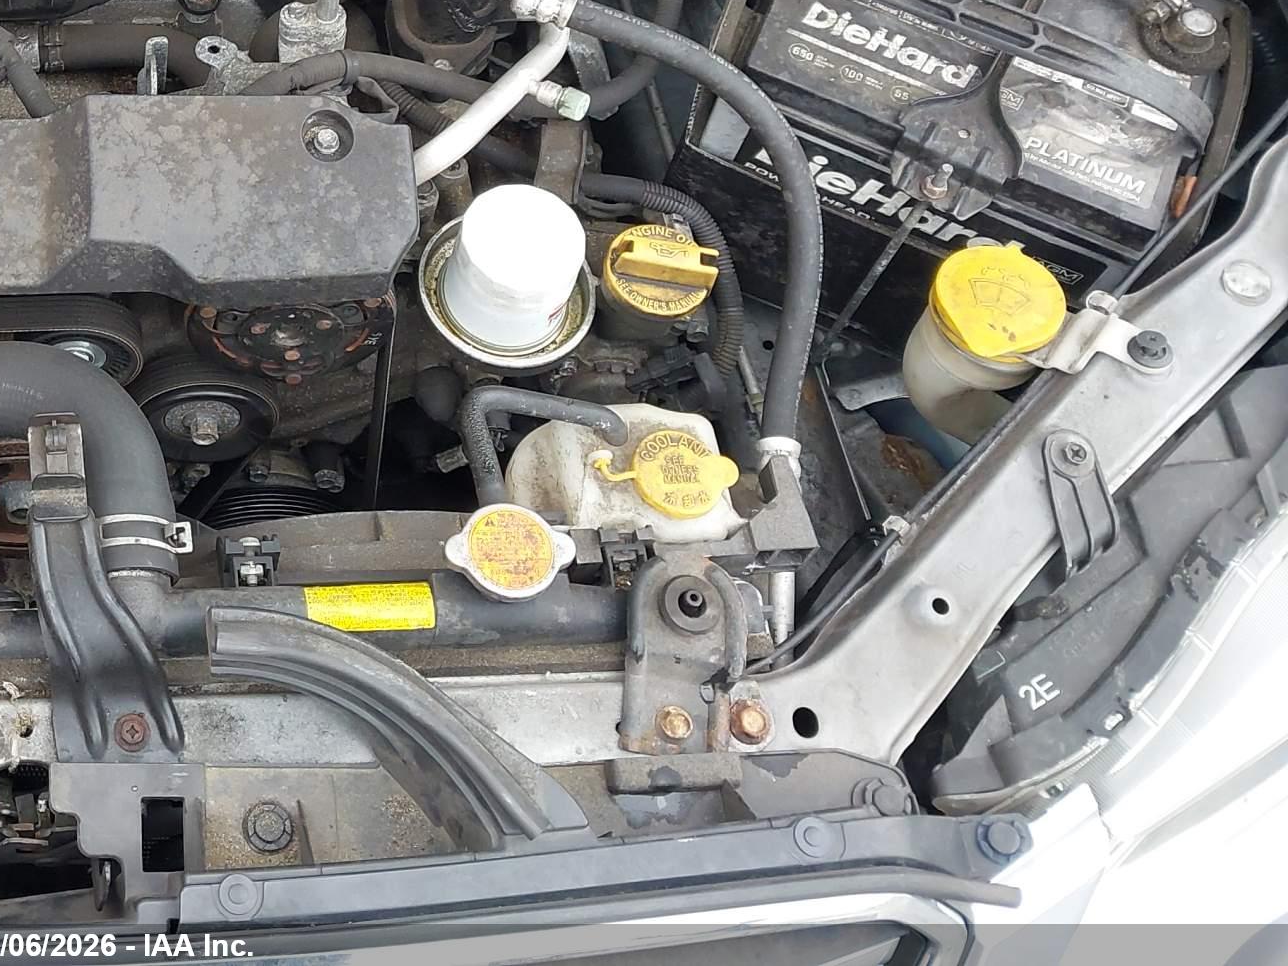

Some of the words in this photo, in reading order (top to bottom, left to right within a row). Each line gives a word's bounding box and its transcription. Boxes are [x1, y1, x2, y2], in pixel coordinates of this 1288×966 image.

[802, 1, 979, 88] DieHard
[792, 45, 814, 62] 650
[844, 66, 864, 82] 100
[1024, 136, 1147, 195] PLATINUM
[631, 224, 675, 239] NGINE
[616, 277, 632, 292] SEE
[630, 289, 668, 312] OWNER'S
[667, 291, 702, 312] MANUAL
[640, 433, 713, 462] COOLANT
[1018, 673, 1061, 711] 2E
